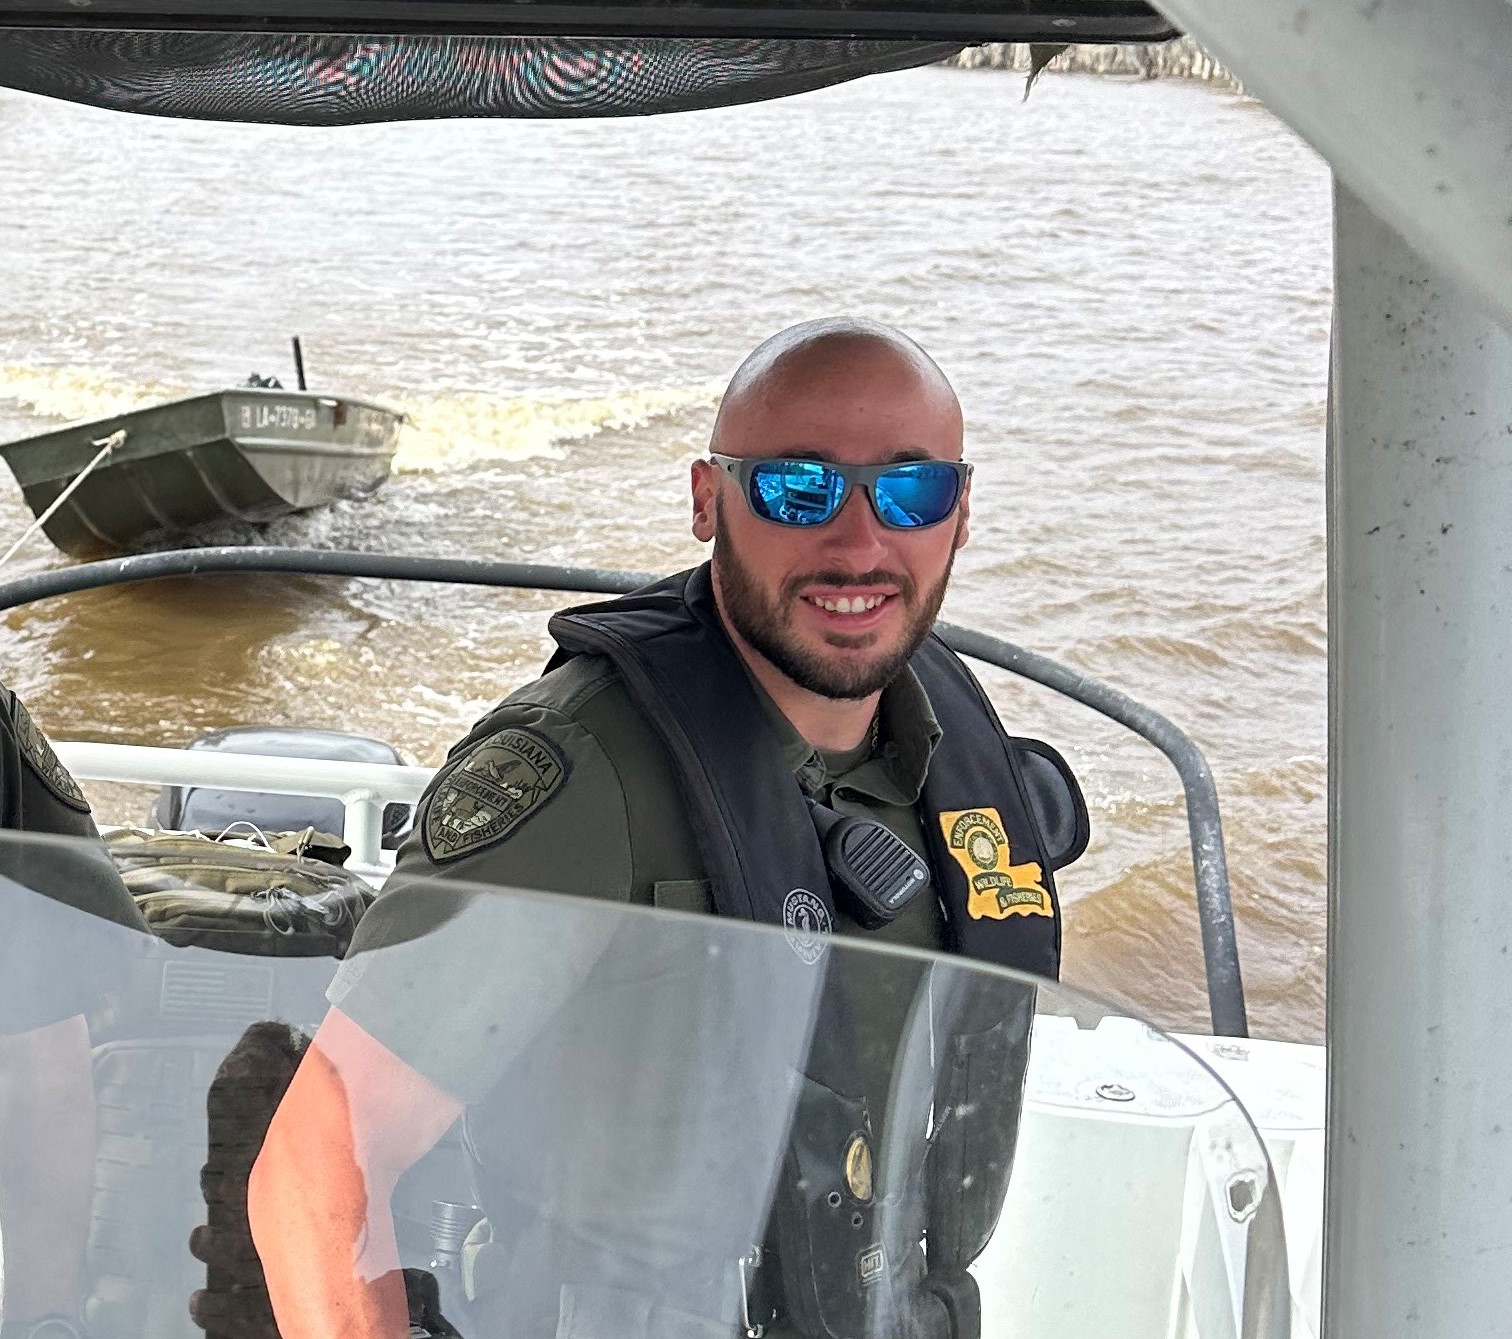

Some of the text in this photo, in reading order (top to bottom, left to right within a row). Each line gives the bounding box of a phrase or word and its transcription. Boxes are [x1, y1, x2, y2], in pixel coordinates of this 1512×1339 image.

[492, 733, 554, 776] UISIANA
[463, 803, 525, 844] FISHERIES
[953, 813, 1005, 848] ENFORCEMENT
